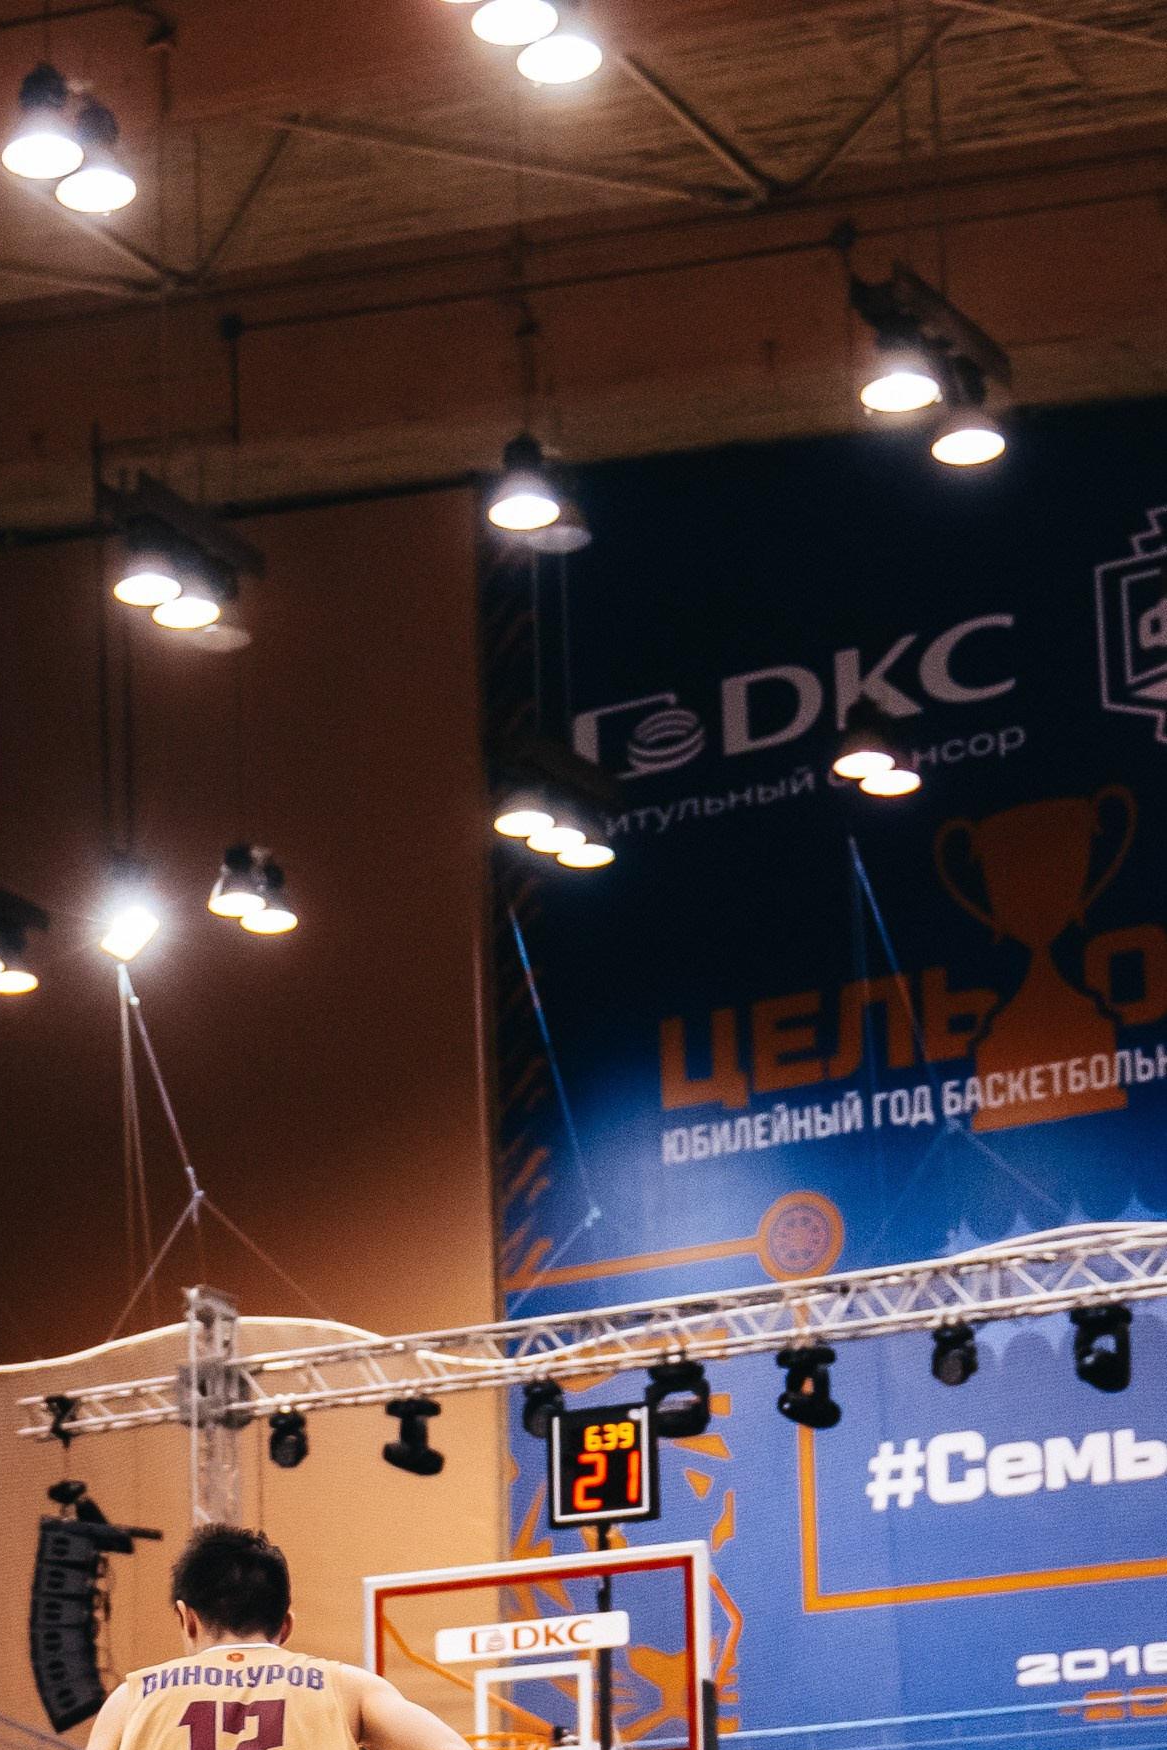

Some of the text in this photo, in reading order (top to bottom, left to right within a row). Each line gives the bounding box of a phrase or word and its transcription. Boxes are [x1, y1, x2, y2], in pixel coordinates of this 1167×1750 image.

[721, 612, 1016, 757] DKC
[604, 725, 1027, 837] итульный снсор
[659, 967, 1000, 1111] ЦЕЛЬ
[662, 1091, 864, 1165] ЮБИЛЕЙНЫЙ
[872, 1085, 935, 1131] ГОД
[572, 1450, 641, 1512] 21
[511, 1619, 593, 1650] DKC
[141, 1663, 325, 1699] ВИНОКУРОВ
